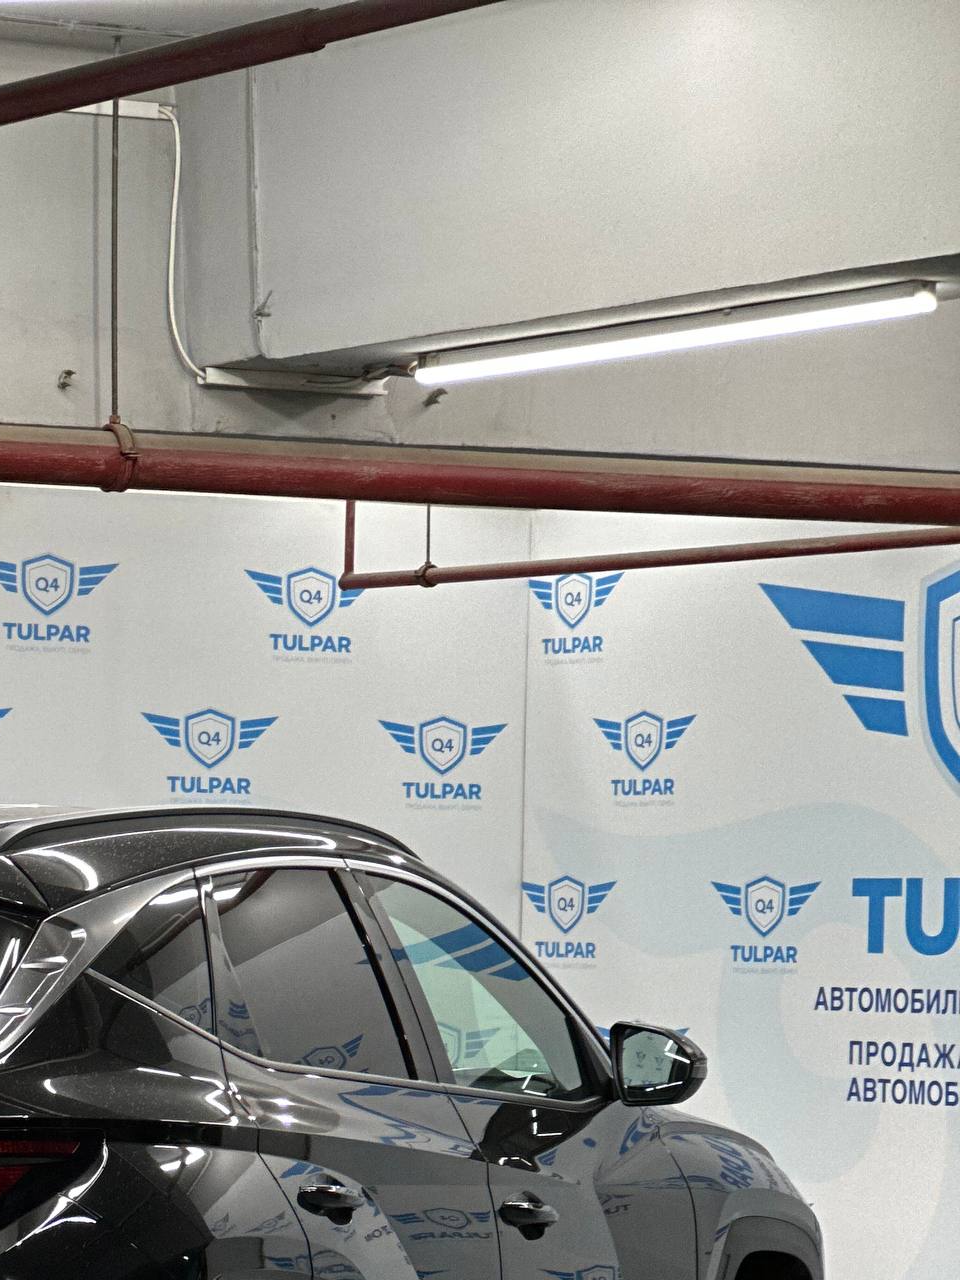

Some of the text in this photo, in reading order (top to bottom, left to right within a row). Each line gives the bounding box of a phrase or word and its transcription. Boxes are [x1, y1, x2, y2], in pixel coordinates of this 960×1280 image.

[35, 577, 60, 592] Q4
[299, 589, 322, 604] Q4
[564, 591, 582, 607] Q4
[2, 622, 90, 643] TULPAR
[269, 633, 352, 653] TULPAR
[542, 635, 604, 655] TULPAR
[197, 731, 221, 746] Q4
[431, 738, 454, 753] Q4
[634, 733, 653, 749] Q4
[166, 775, 251, 794] TULPAR
[402, 782, 482, 800] TULPAR
[611, 778, 675, 796] TULPAR
[557, 897, 575, 912] Q4
[754, 898, 775, 914] Q4
[852, 877, 960, 956] TU
[535, 941, 596, 958] TULPAR
[730, 945, 798, 963] TULPAR
[813, 986, 960, 1015] АВТОМОБИЛ
[848, 1040, 960, 1072] ПРОДАЖ
[846, 1077, 959, 1107] АВТОМОБ
